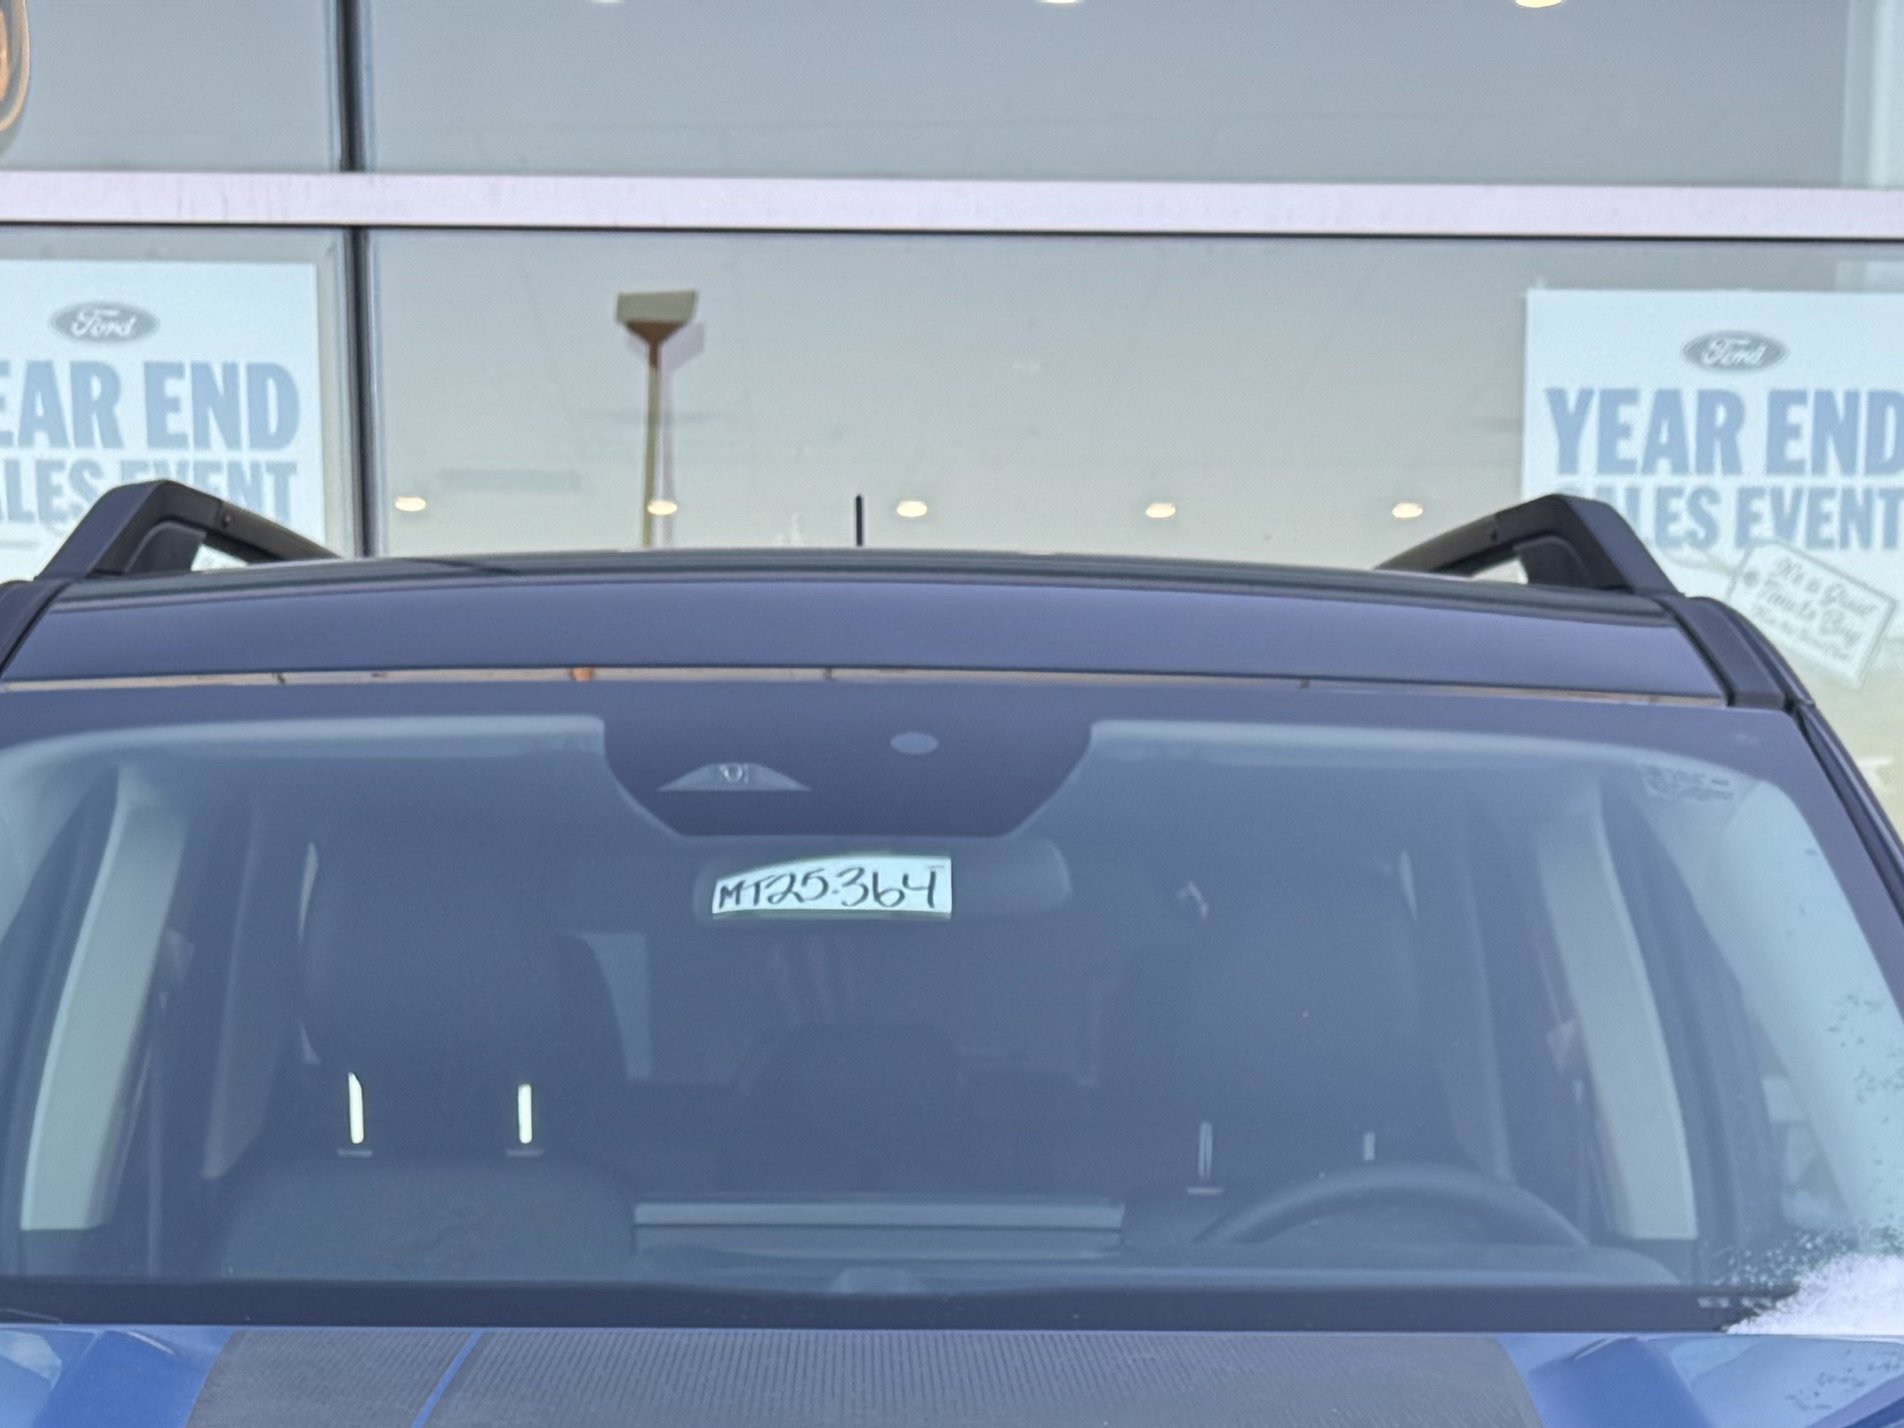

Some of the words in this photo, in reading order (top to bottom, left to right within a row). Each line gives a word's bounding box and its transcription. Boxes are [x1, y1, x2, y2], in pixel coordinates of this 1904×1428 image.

[70, 307, 136, 338] Ford
[1702, 337, 1766, 367] Ford
[143, 361, 300, 451] END
[1545, 387, 1746, 476] YEAR
